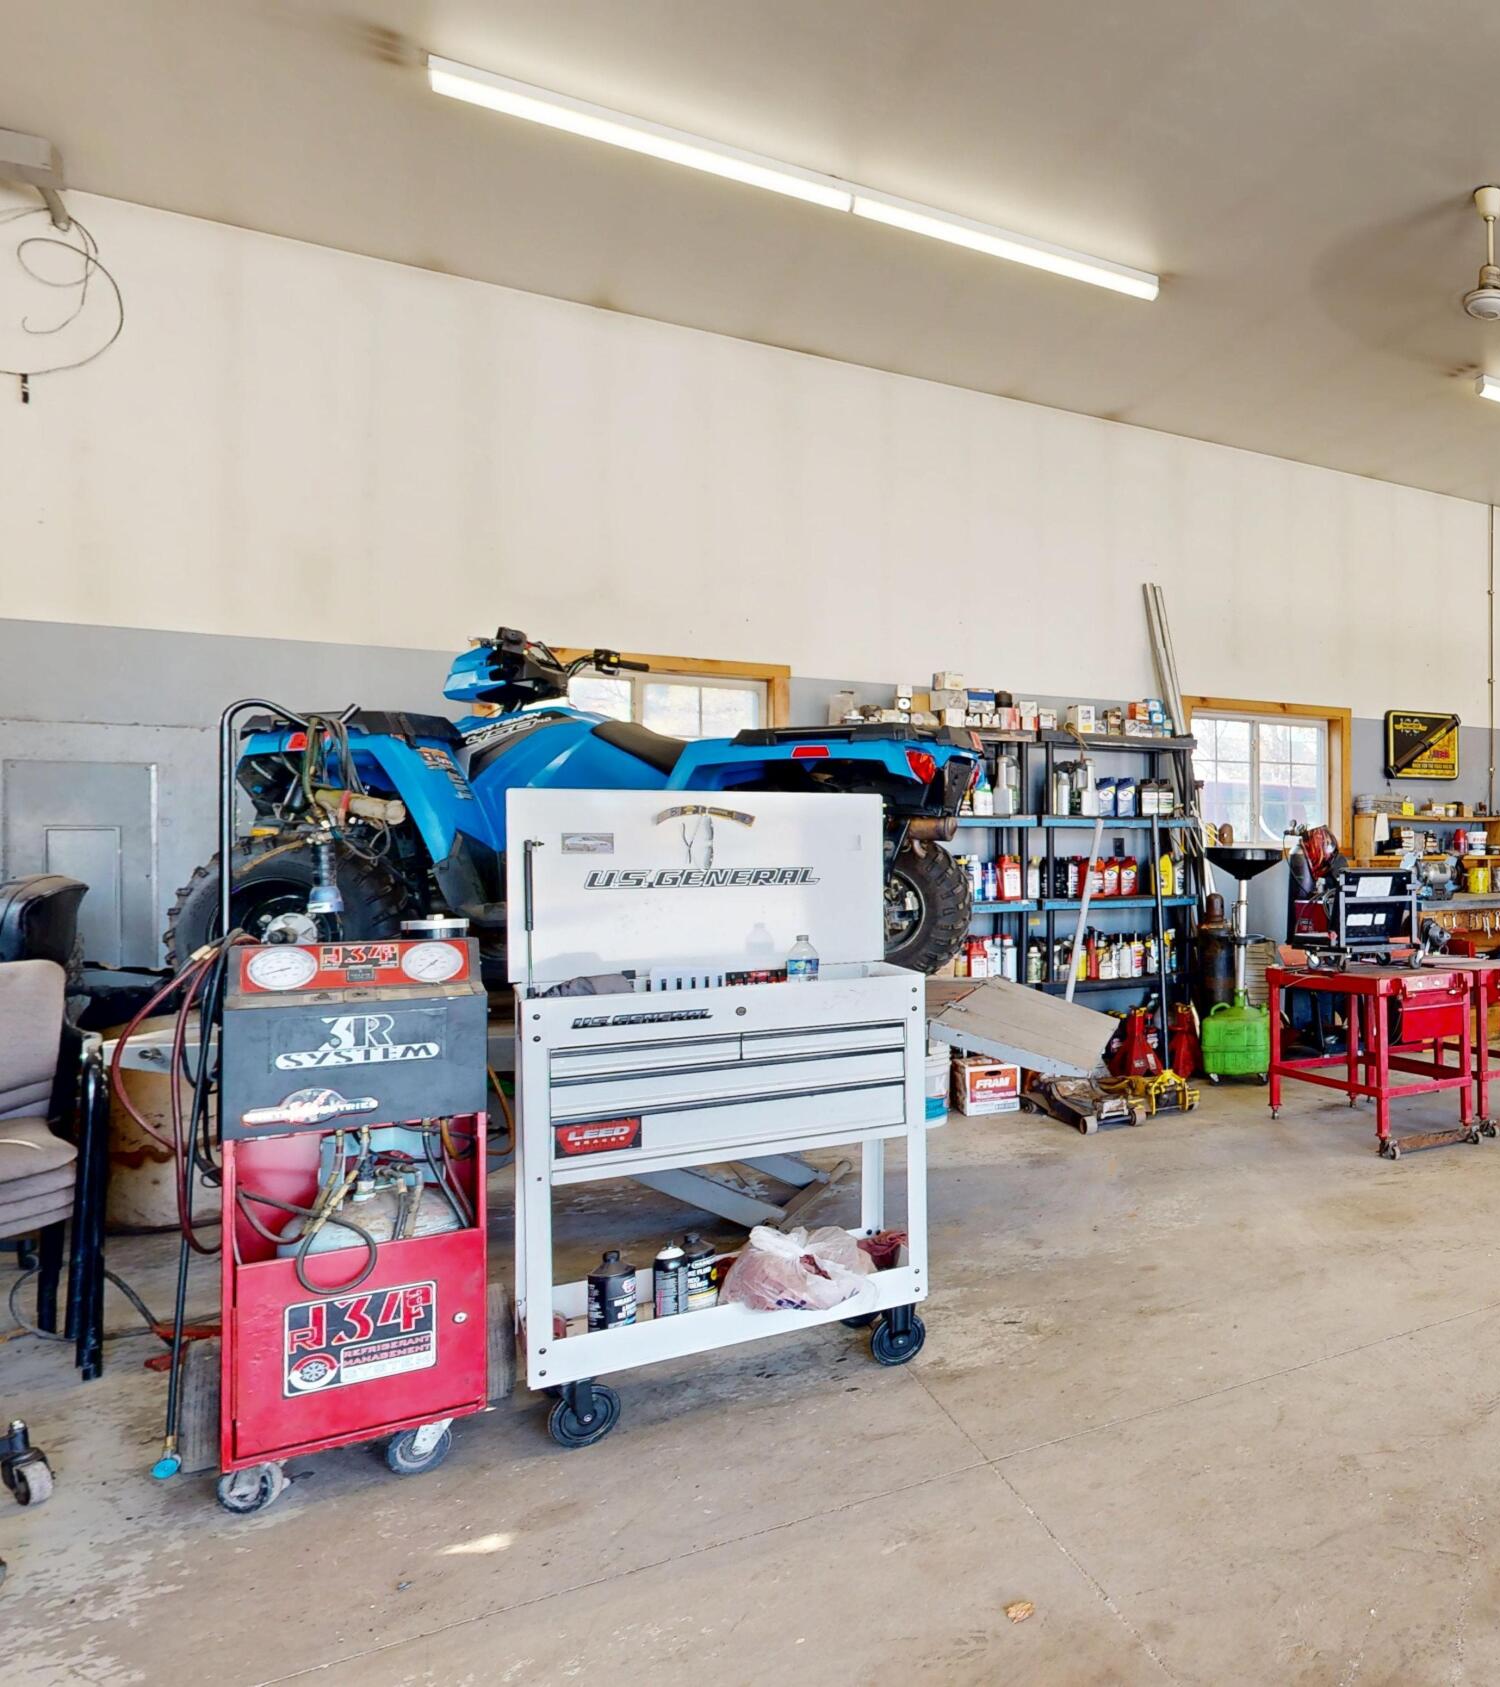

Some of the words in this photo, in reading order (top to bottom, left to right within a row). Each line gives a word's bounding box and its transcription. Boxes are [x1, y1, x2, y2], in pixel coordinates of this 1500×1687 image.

[282, 1045, 434, 1068] SYSTEM
[975, 1076, 1011, 1089] FRAM
[568, 1126, 630, 1141] LEED
